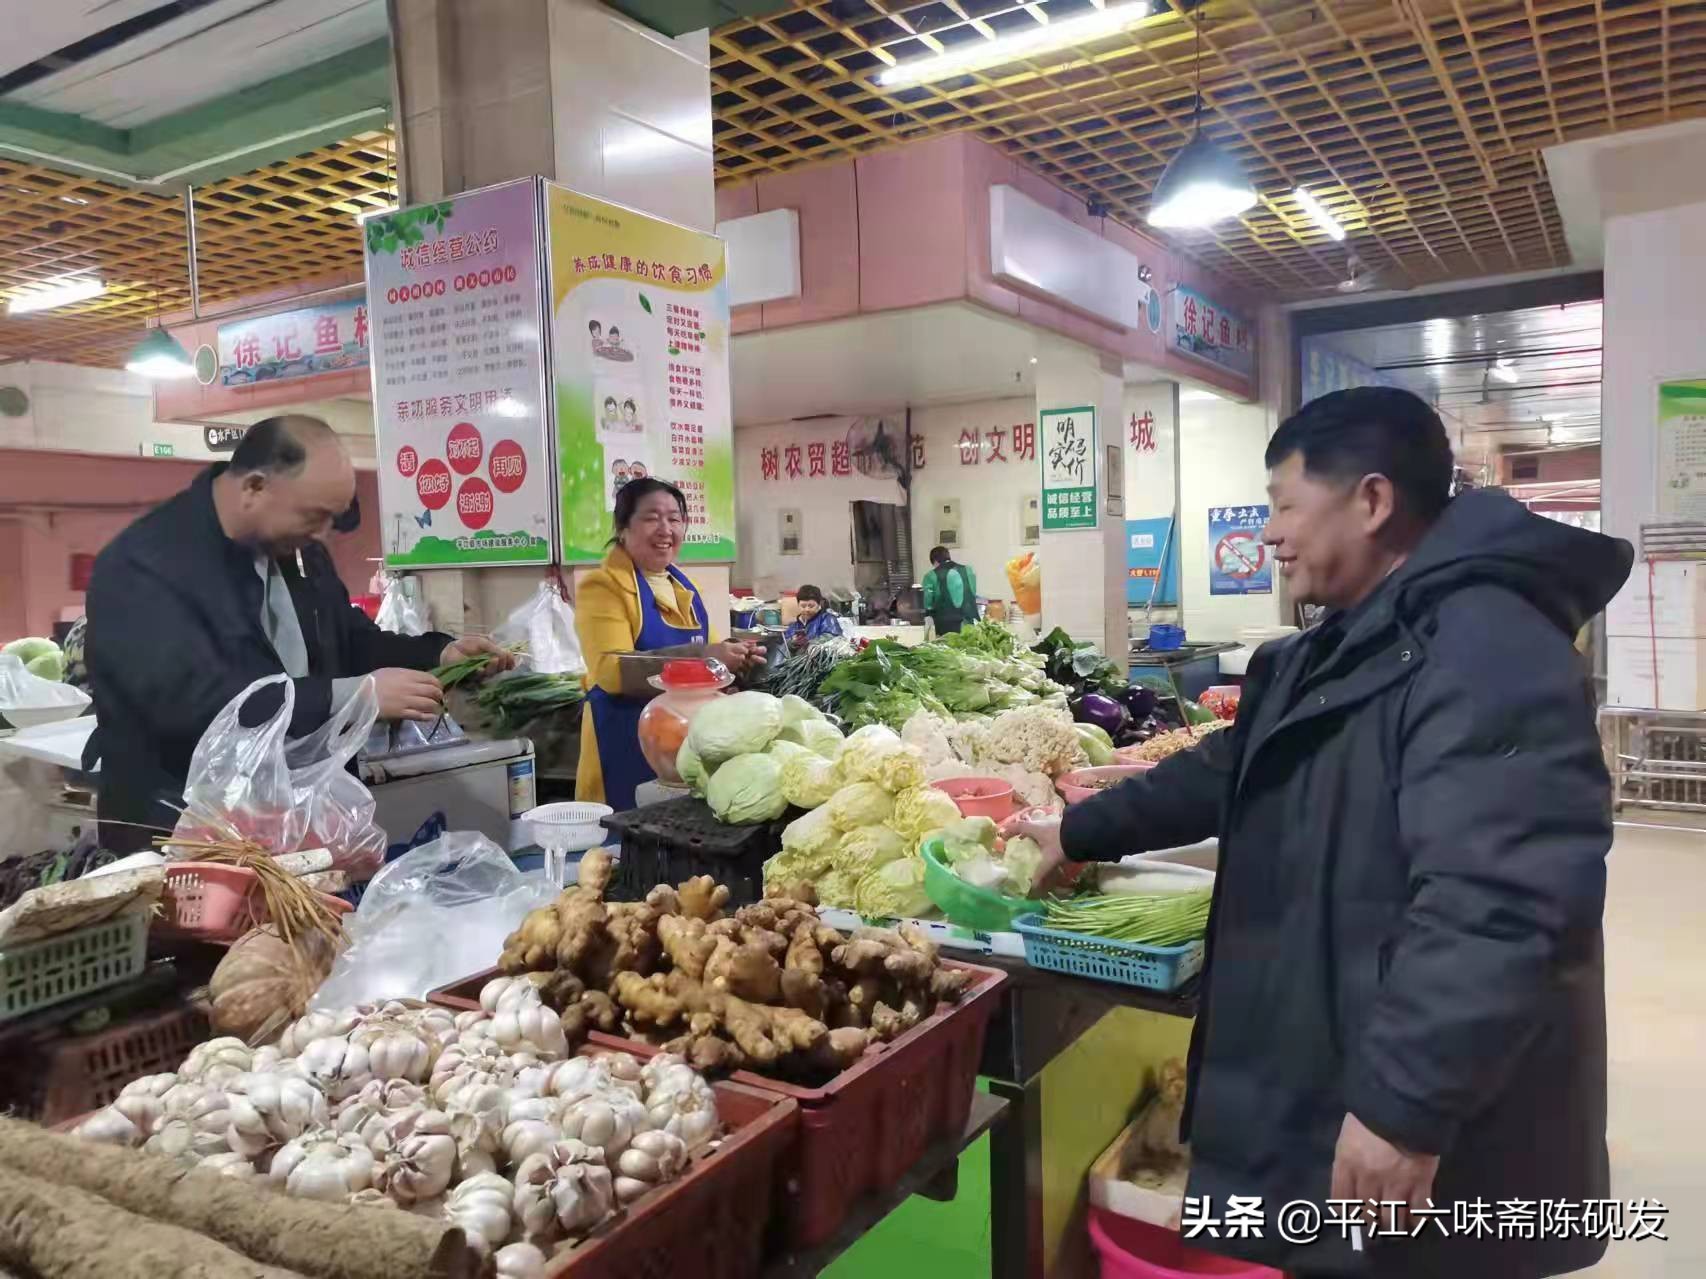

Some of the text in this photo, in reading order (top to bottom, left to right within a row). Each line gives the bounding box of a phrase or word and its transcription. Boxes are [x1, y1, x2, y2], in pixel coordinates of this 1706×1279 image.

[400, 230, 498, 269] 诚信经营公约
[573, 253, 713, 284] 养成健康的饮食习惯
[1130, 410, 1157, 453] 城
[449, 438, 480, 459] 对不起
[399, 452, 416, 472] 请
[493, 455, 523, 477] 再见
[419, 473, 450, 494] 您好
[459, 491, 490, 513] 谢谢
[1047, 491, 1093, 505] 诚信经营
[1047, 506, 1093, 519] 品质至上
